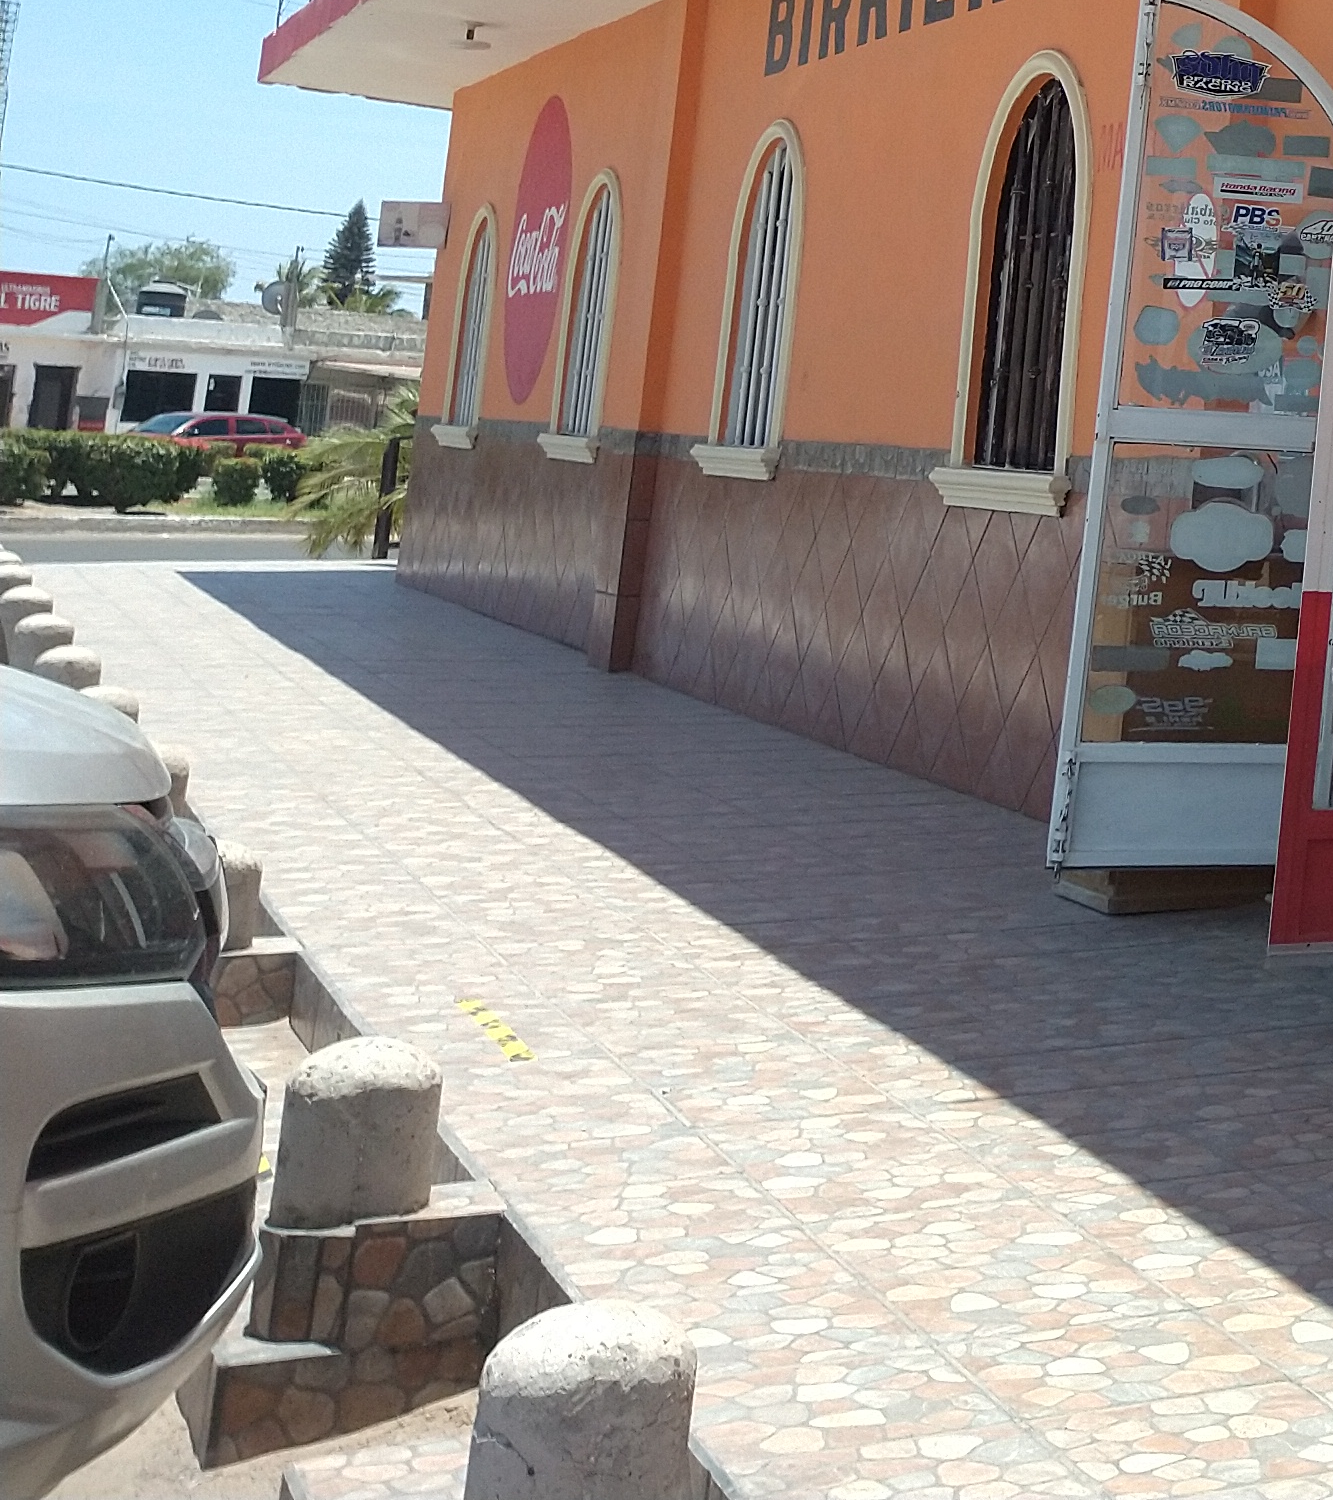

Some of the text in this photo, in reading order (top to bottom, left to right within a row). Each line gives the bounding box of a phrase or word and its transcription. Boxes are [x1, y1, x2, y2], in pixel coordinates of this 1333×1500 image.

[1183, 79, 1252, 92] RACING
[1221, 182, 1257, 191] Honda
[1258, 185, 1297, 196] Racing
[1232, 204, 1282, 227] PBS
[1179, 280, 1233, 290] PRO COMP
[17, 293, 60, 312] TIGRE
